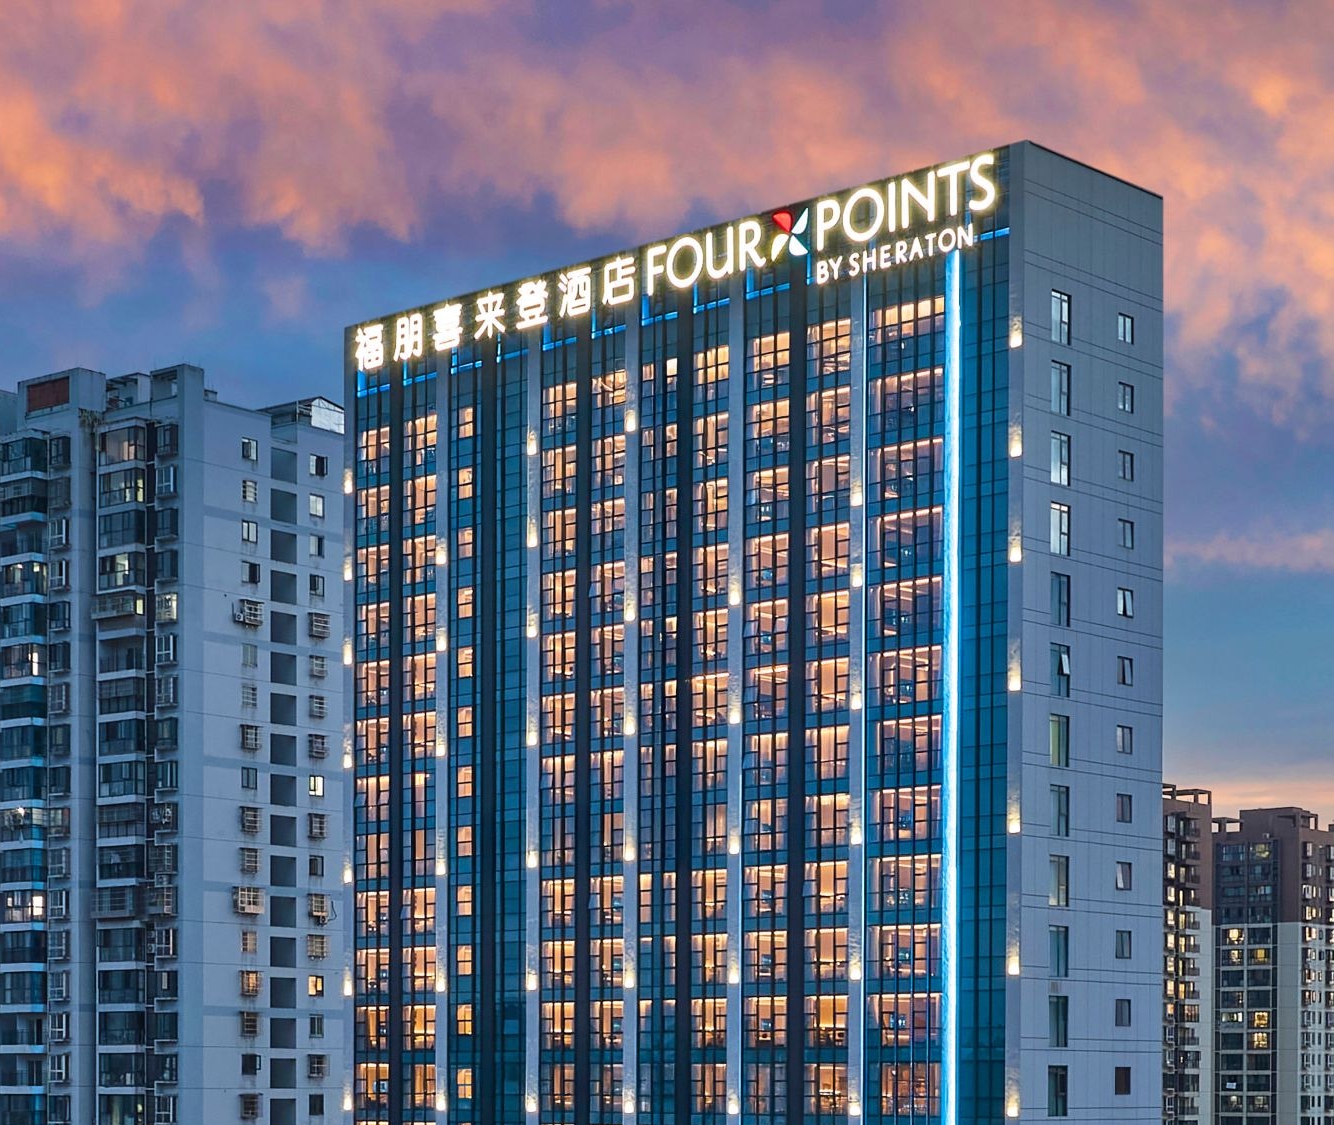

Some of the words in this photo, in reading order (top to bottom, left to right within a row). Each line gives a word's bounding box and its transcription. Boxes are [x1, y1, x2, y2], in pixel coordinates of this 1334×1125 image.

[646, 219, 767, 296] FOUR
[816, 153, 996, 251] POINTS
[816, 258, 843, 286] BY
[849, 223, 975, 277] SHERATON
[355, 256, 637, 371] 福朋喜来登酒店
